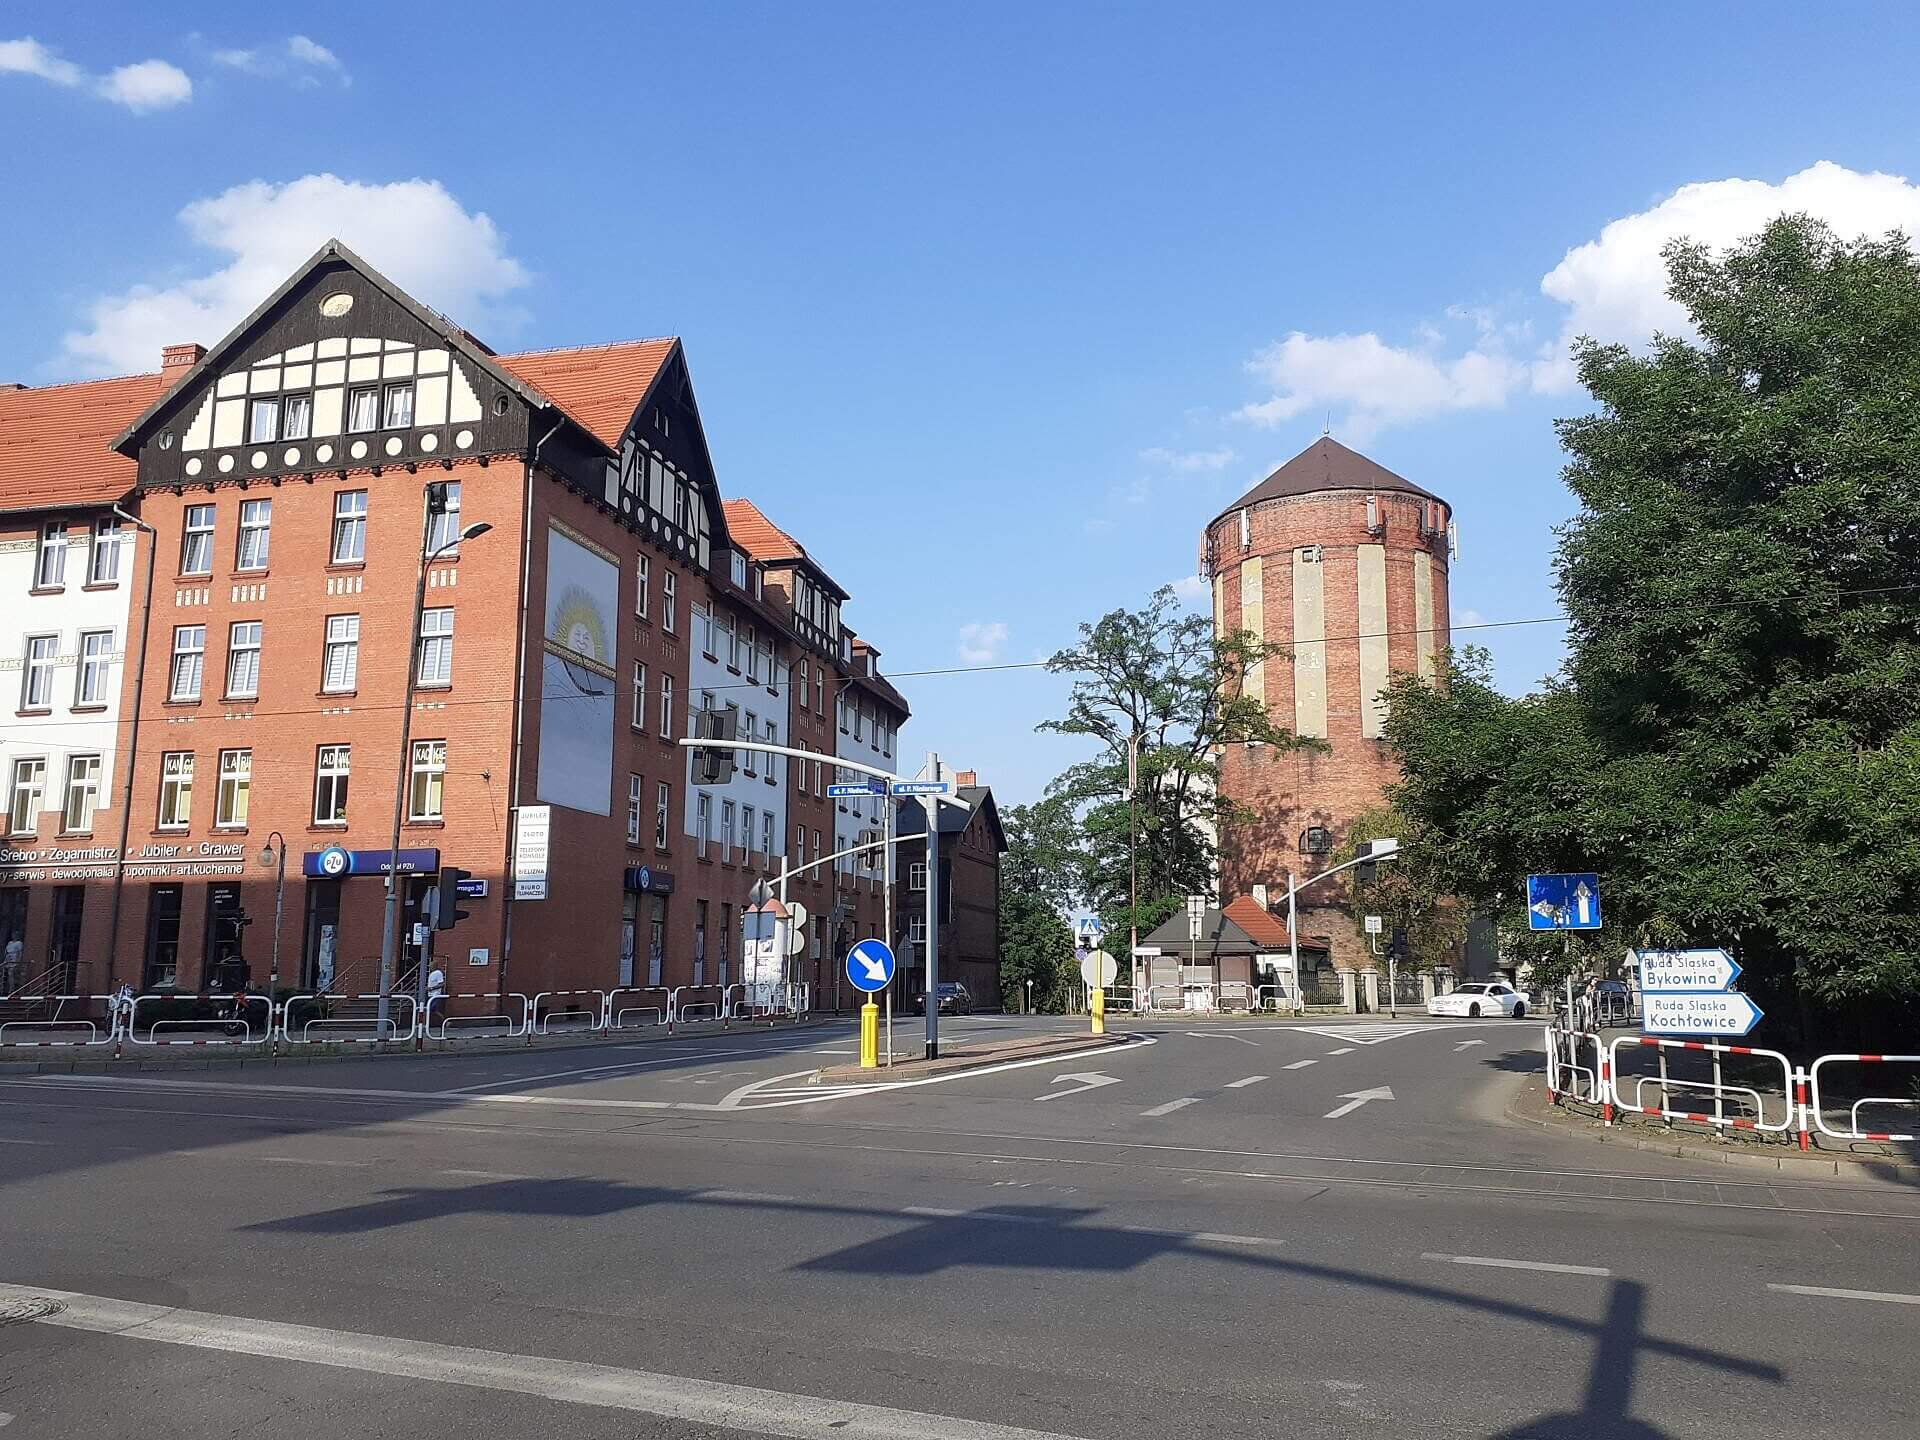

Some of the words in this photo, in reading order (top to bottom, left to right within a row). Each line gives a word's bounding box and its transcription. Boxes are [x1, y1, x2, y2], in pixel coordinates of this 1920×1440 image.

[0, 849, 37, 862] Srebro
[48, 846, 117, 863] Zegarmistrz
[139, 843, 180, 857] Jubiler
[199, 841, 244, 855] Grawer
[326, 856, 342, 869] PZU
[51, 866, 114, 880] dewocjonalia
[1644, 957, 1673, 969] Ruda
[1647, 972, 1717, 988] Bykowina
[1655, 1000, 1683, 1011] Ruda
[1650, 1014, 1737, 1028] Kochłowice
